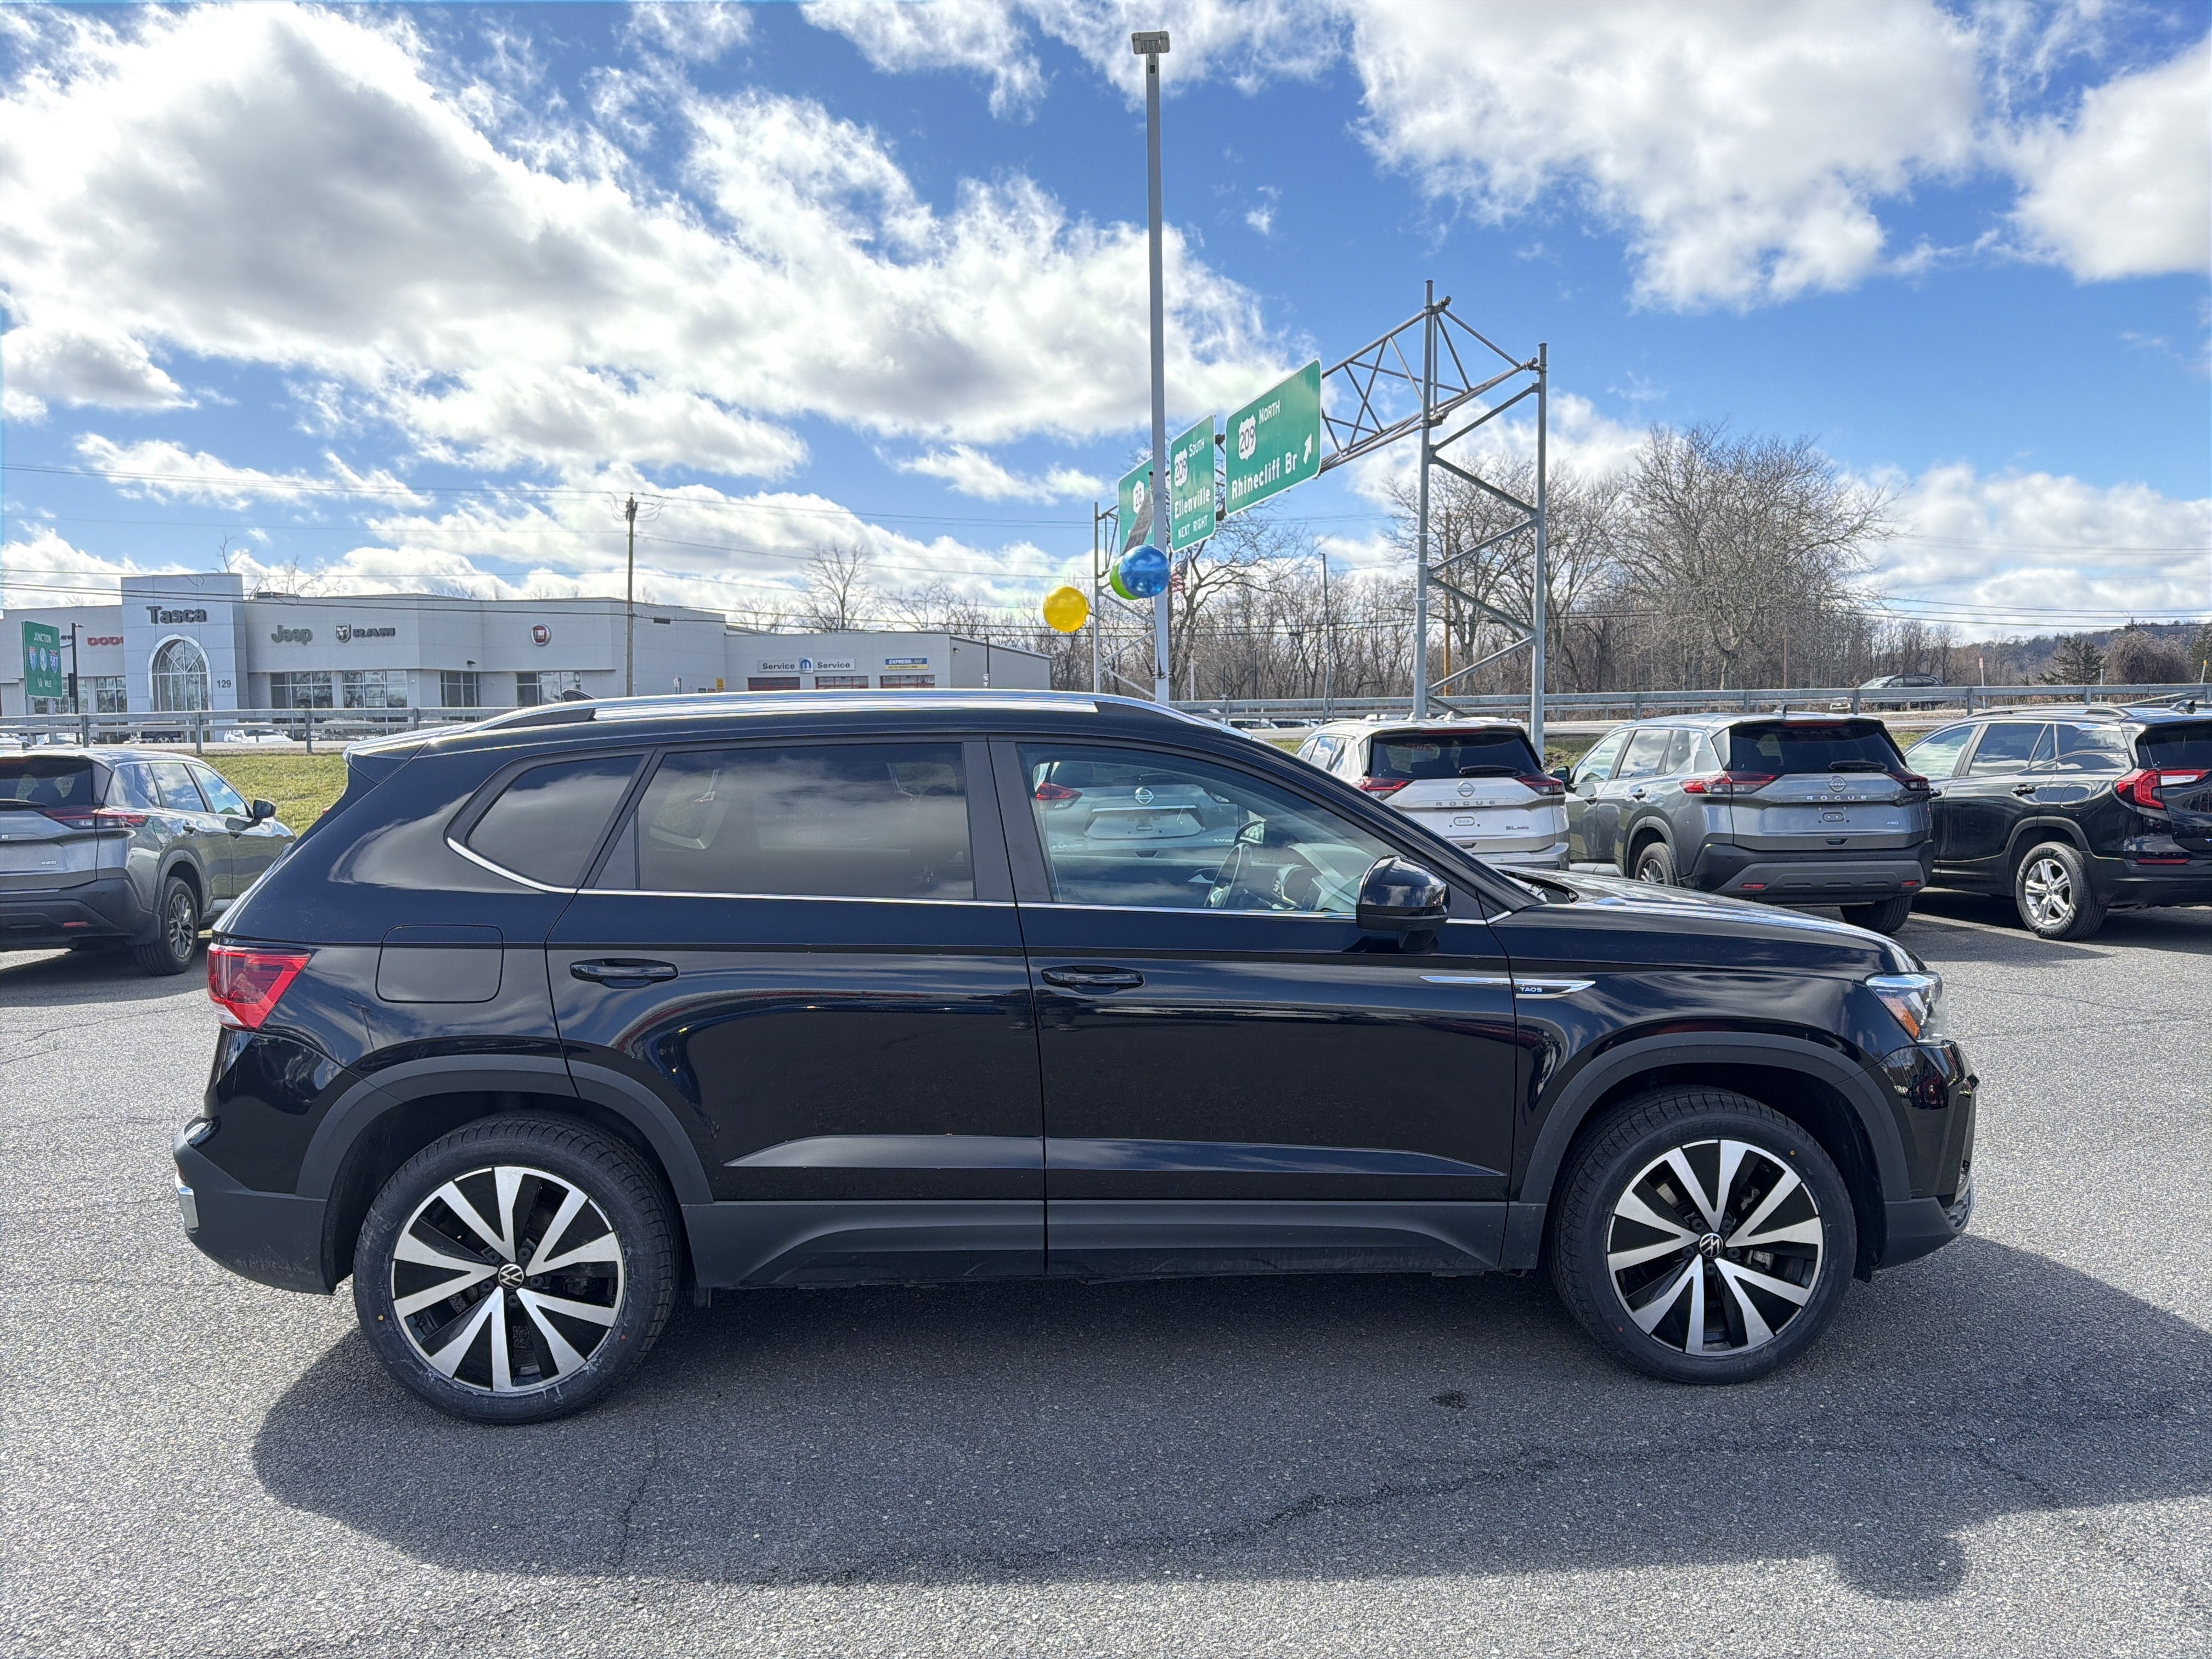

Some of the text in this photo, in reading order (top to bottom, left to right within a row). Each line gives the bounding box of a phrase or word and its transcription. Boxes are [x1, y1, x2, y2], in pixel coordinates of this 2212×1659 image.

[1259, 399, 1280, 425] NORTH
[1189, 437, 1205, 458] SOUTH
[1240, 425, 1255, 453] 209
[1175, 457, 1187, 481] 209
[1232, 452, 1297, 500] Rhinecliff Br
[1175, 486, 1210, 520] Ellenville
[1178, 515, 1208, 539] NEXT RIGHT
[146, 606, 207, 624] Tasca
[33, 632, 52, 643] JUNCTION
[271, 624, 313, 645] Jeep
[353, 628, 396, 637] RAM
[217, 679, 232, 688] 129
